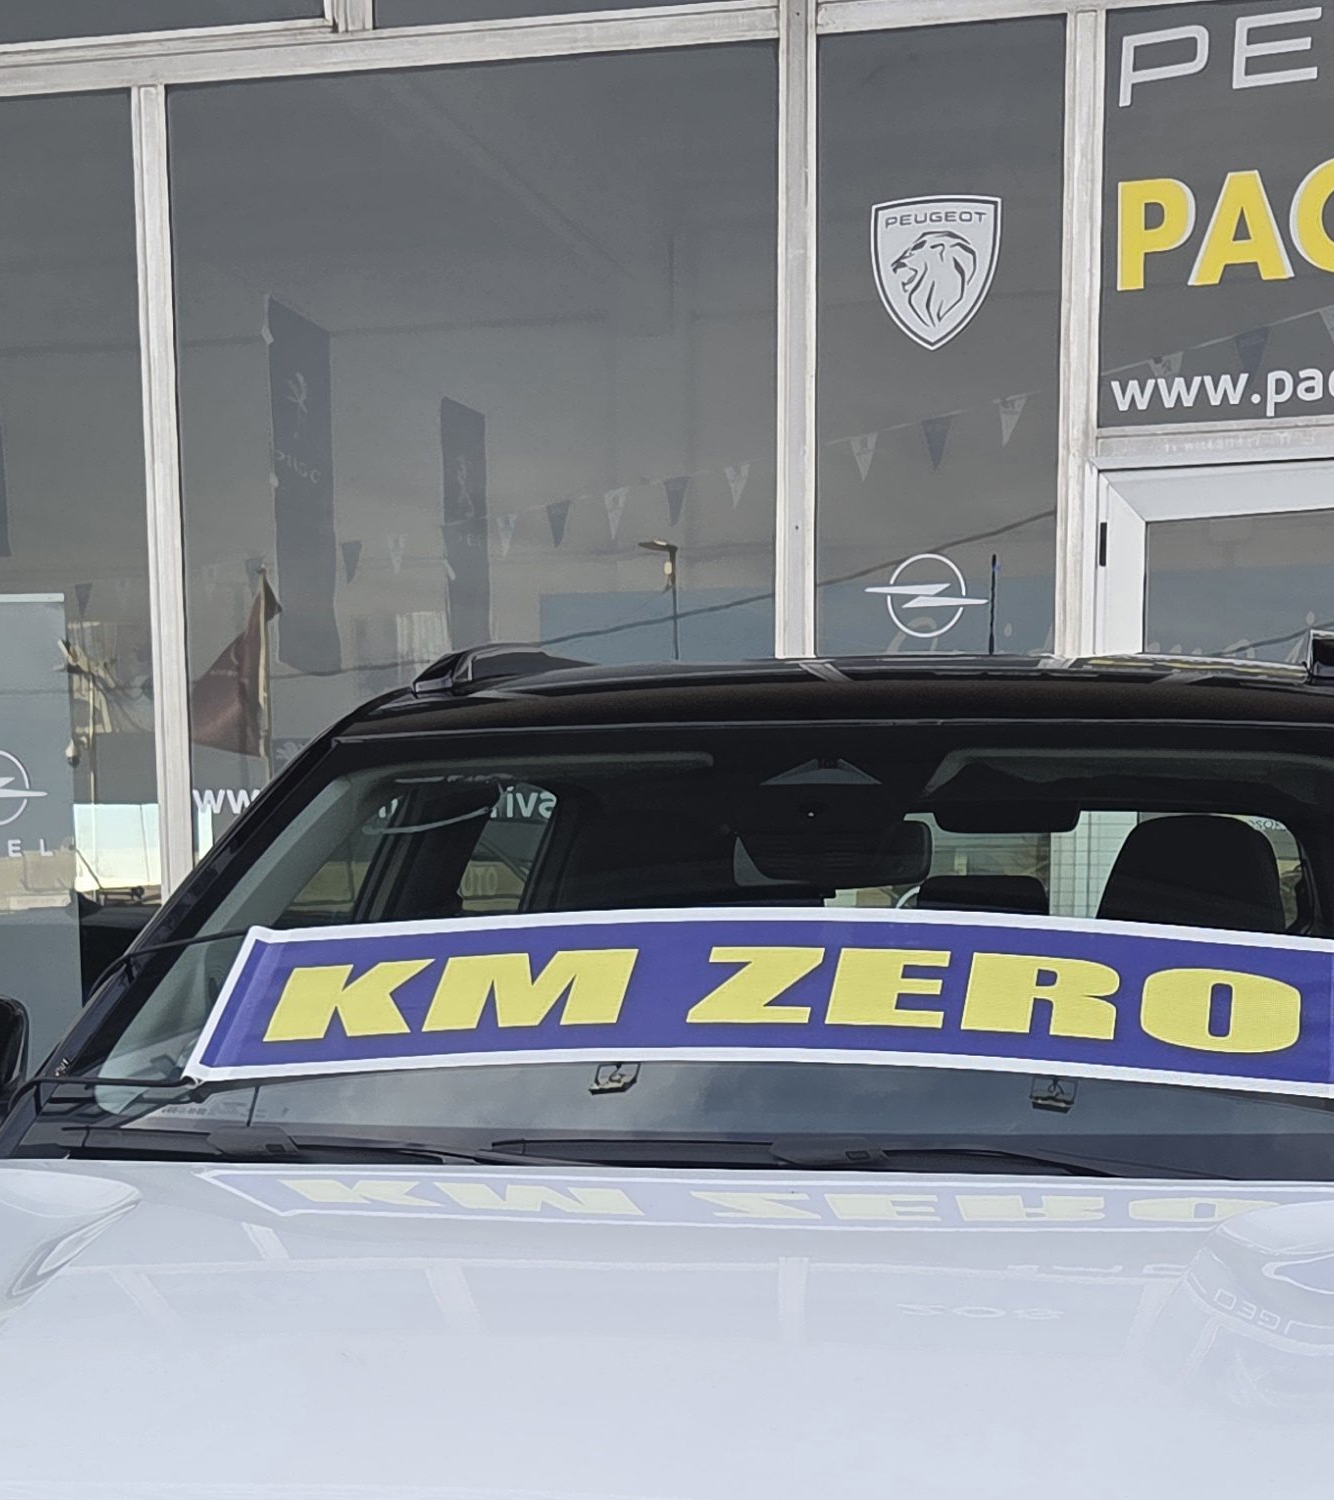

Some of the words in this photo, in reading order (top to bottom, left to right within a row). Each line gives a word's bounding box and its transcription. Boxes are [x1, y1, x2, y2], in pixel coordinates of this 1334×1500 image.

[884, 210, 988, 229] PEUGEOT
[263, 948, 640, 1042] KM
[685, 946, 1302, 1054] ZERO
